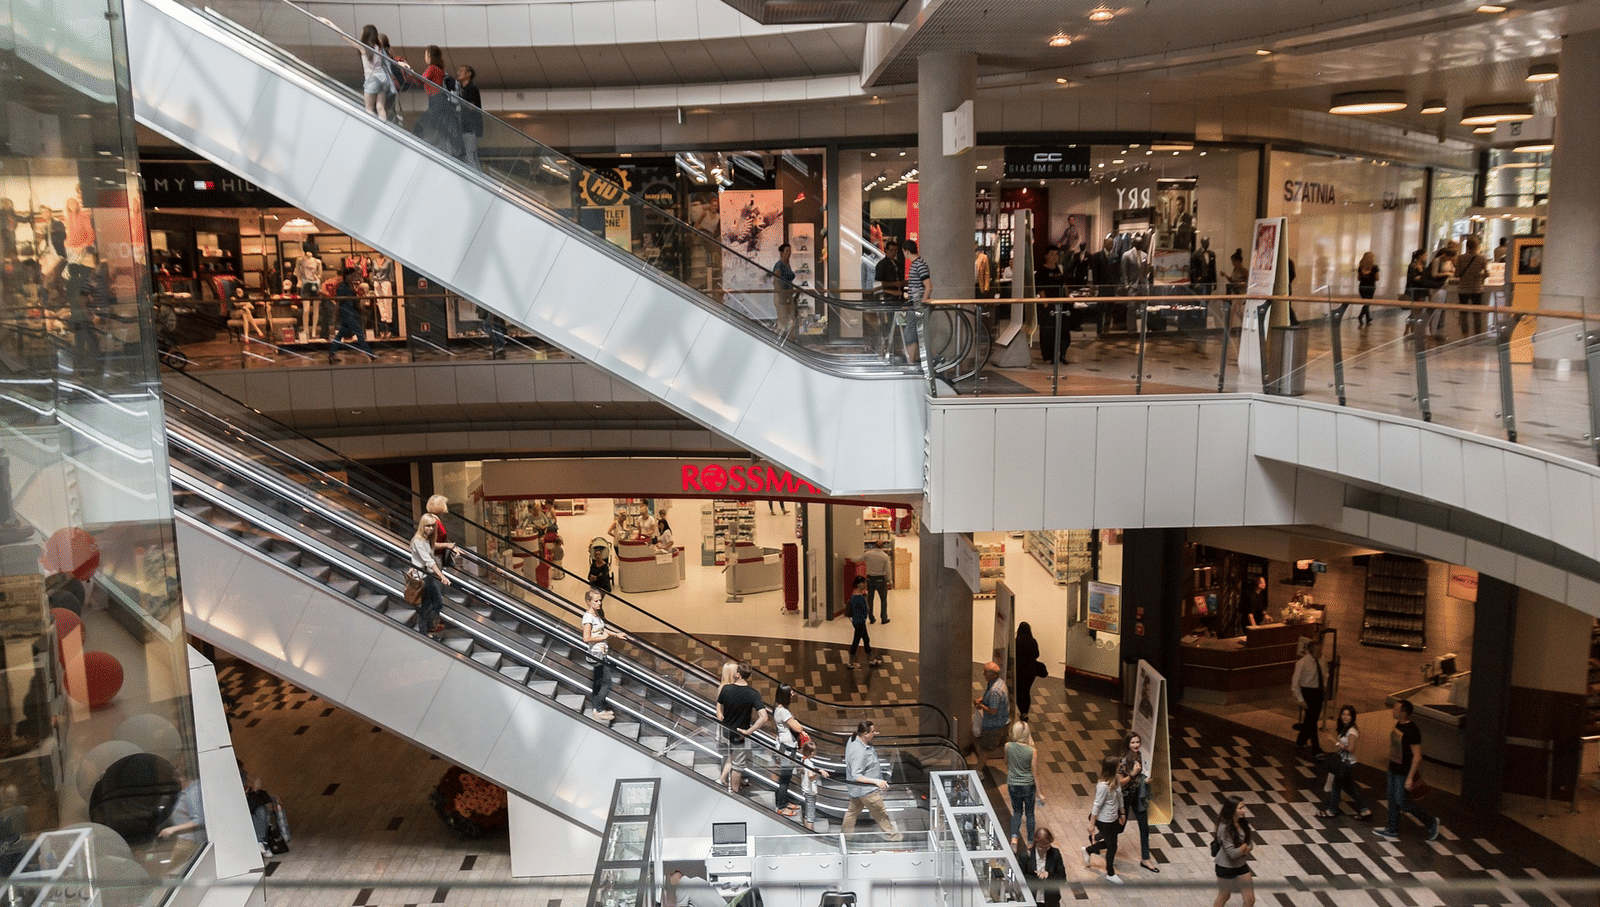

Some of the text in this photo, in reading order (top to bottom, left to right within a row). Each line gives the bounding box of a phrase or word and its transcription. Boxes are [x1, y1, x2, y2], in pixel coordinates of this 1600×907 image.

[222, 179, 260, 191] HIL
[1284, 179, 1336, 204] SZATNIA
[605, 209, 625, 219] TLET
[681, 464, 822, 494] ROSSMA
